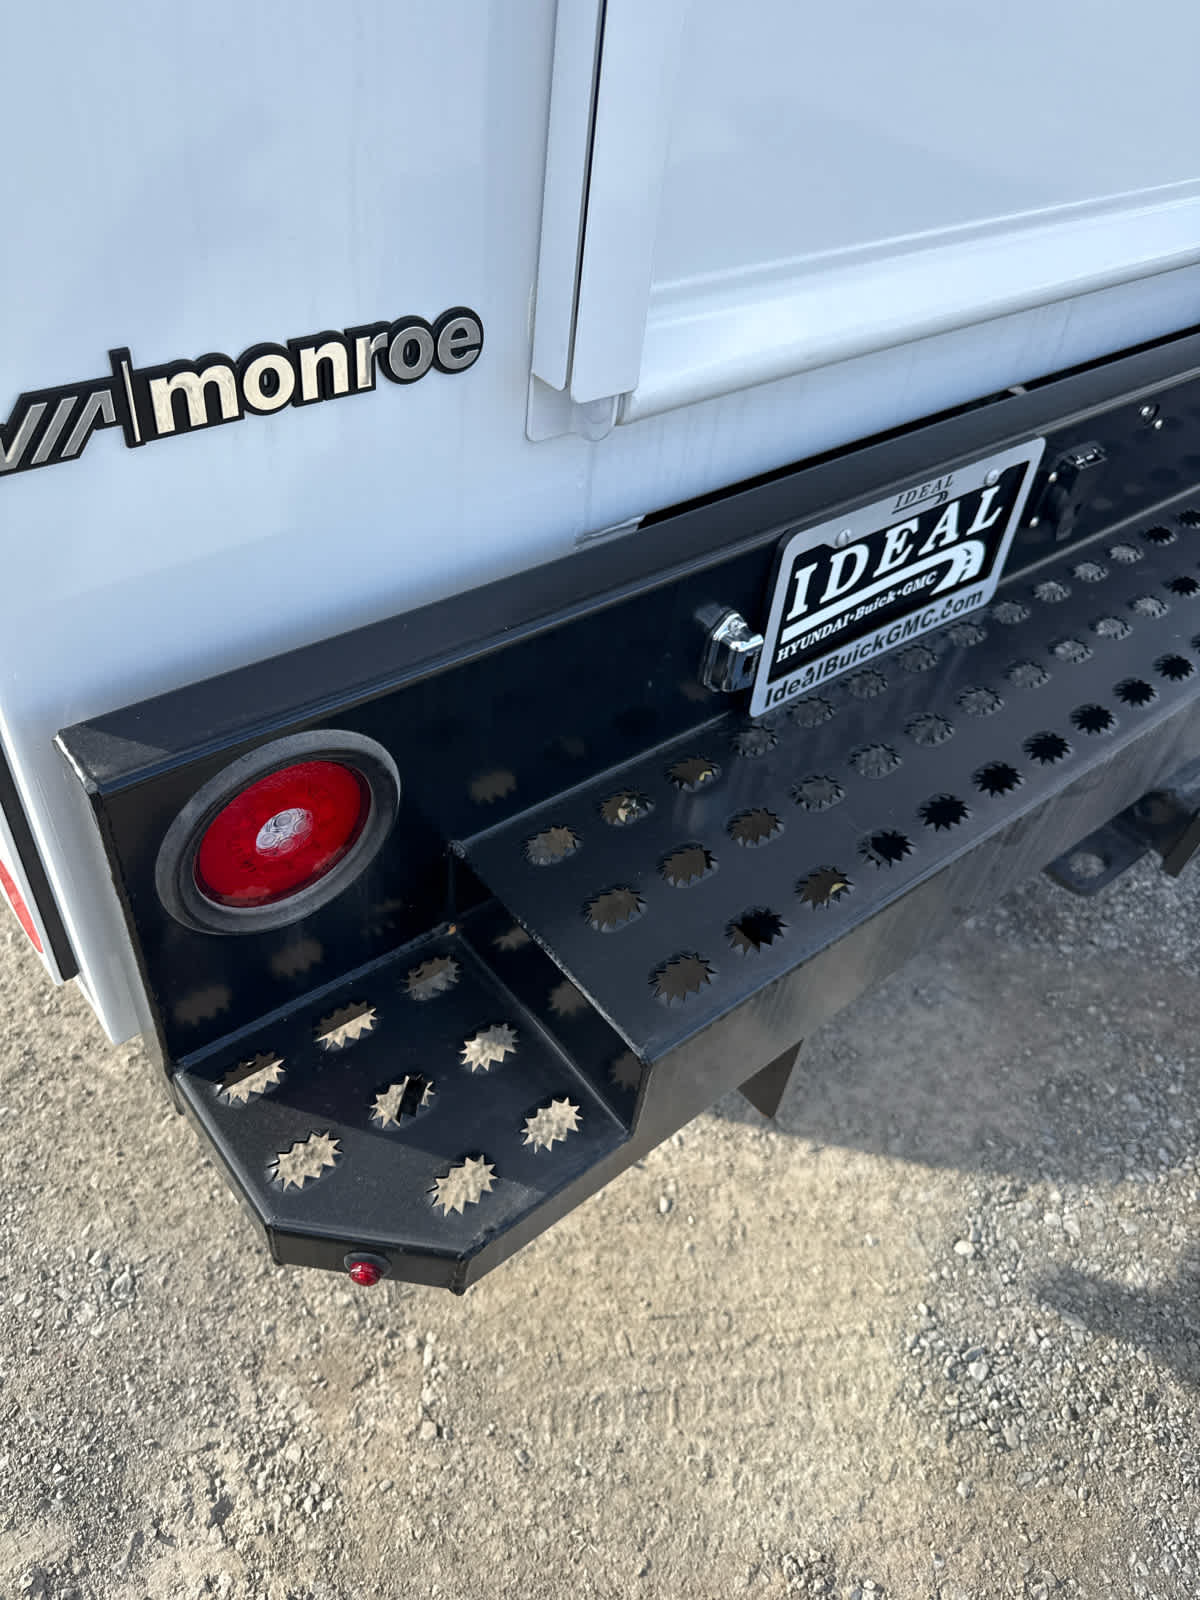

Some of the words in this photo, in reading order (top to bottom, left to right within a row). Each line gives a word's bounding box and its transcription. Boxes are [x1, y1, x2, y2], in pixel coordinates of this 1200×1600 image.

[150, 317, 481, 434] monroe
[894, 474, 953, 508] IDEAL
[786, 485, 1004, 621] IDEAL
[764, 590, 983, 707] IdealBuickGMC.com
